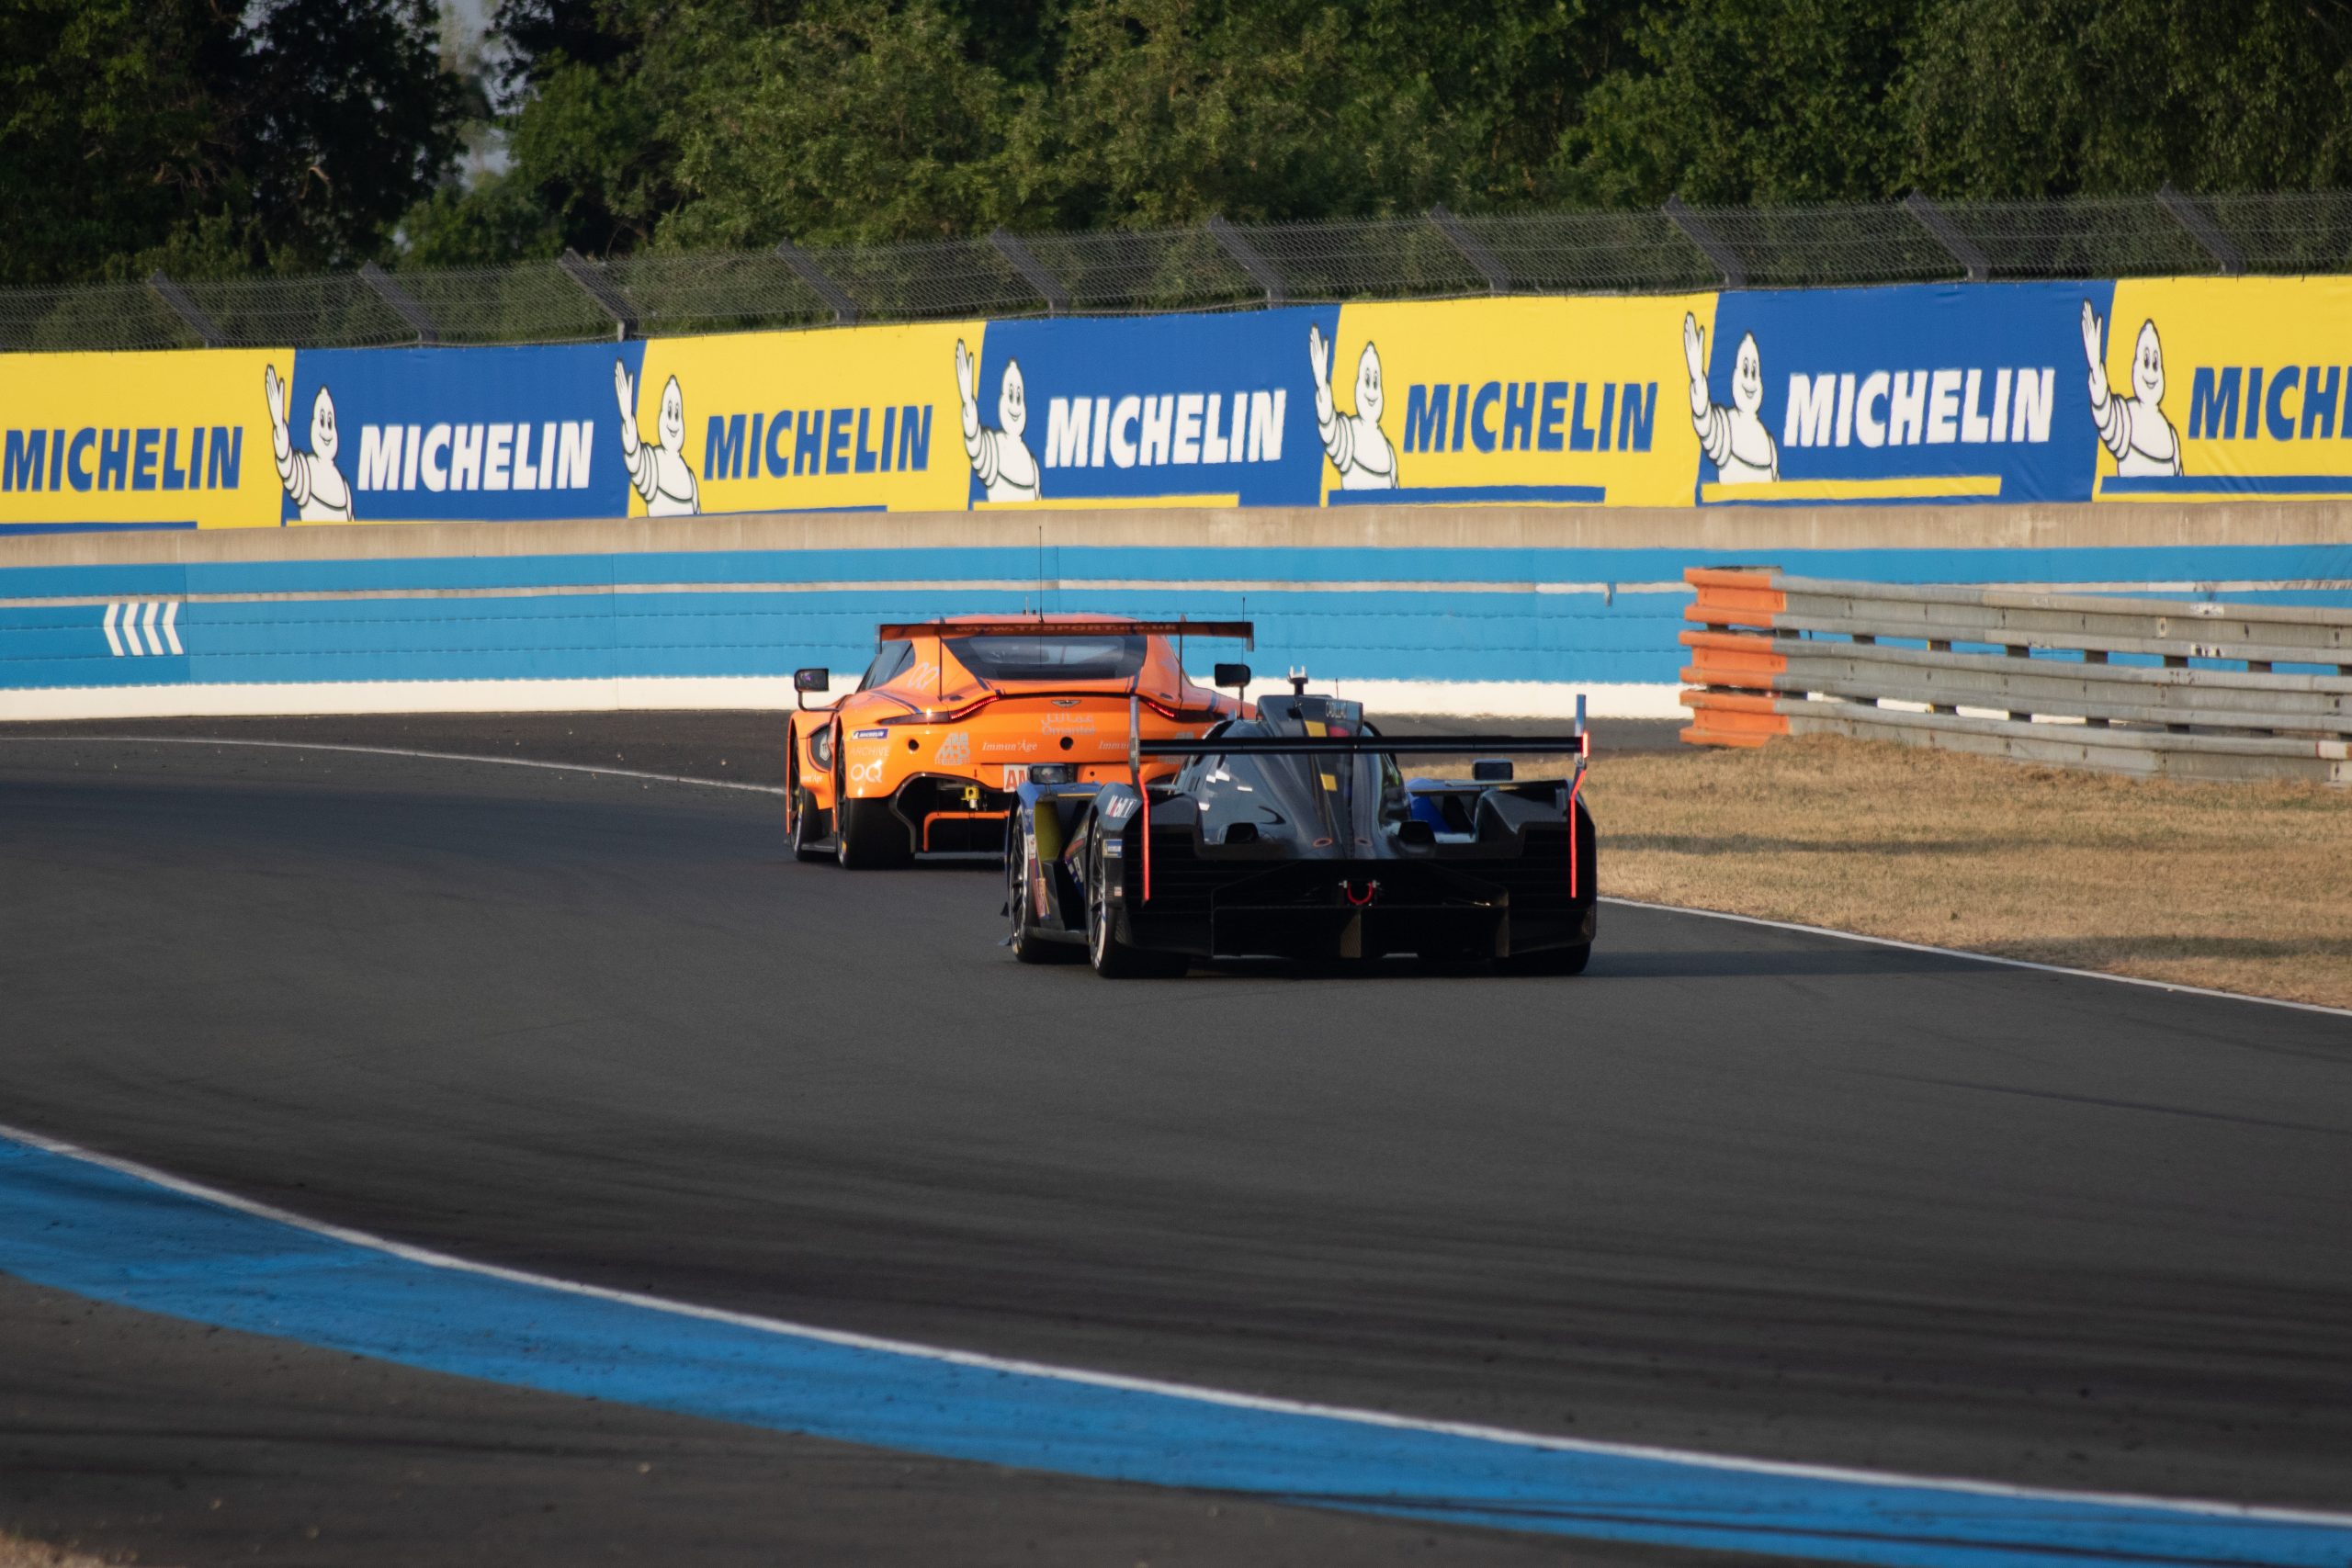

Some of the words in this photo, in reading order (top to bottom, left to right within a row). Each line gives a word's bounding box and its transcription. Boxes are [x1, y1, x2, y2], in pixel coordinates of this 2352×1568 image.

[705, 405, 932, 479] MICHELIN
[1045, 389, 1287, 468] MICHELIN
[1403, 381, 1657, 452] MICHELIN
[1783, 367, 2055, 448] MICHELIN
[3, 427, 243, 491] MICHELIN
[357, 420, 594, 492] MICHELIN
[851, 762, 883, 784] OQ
